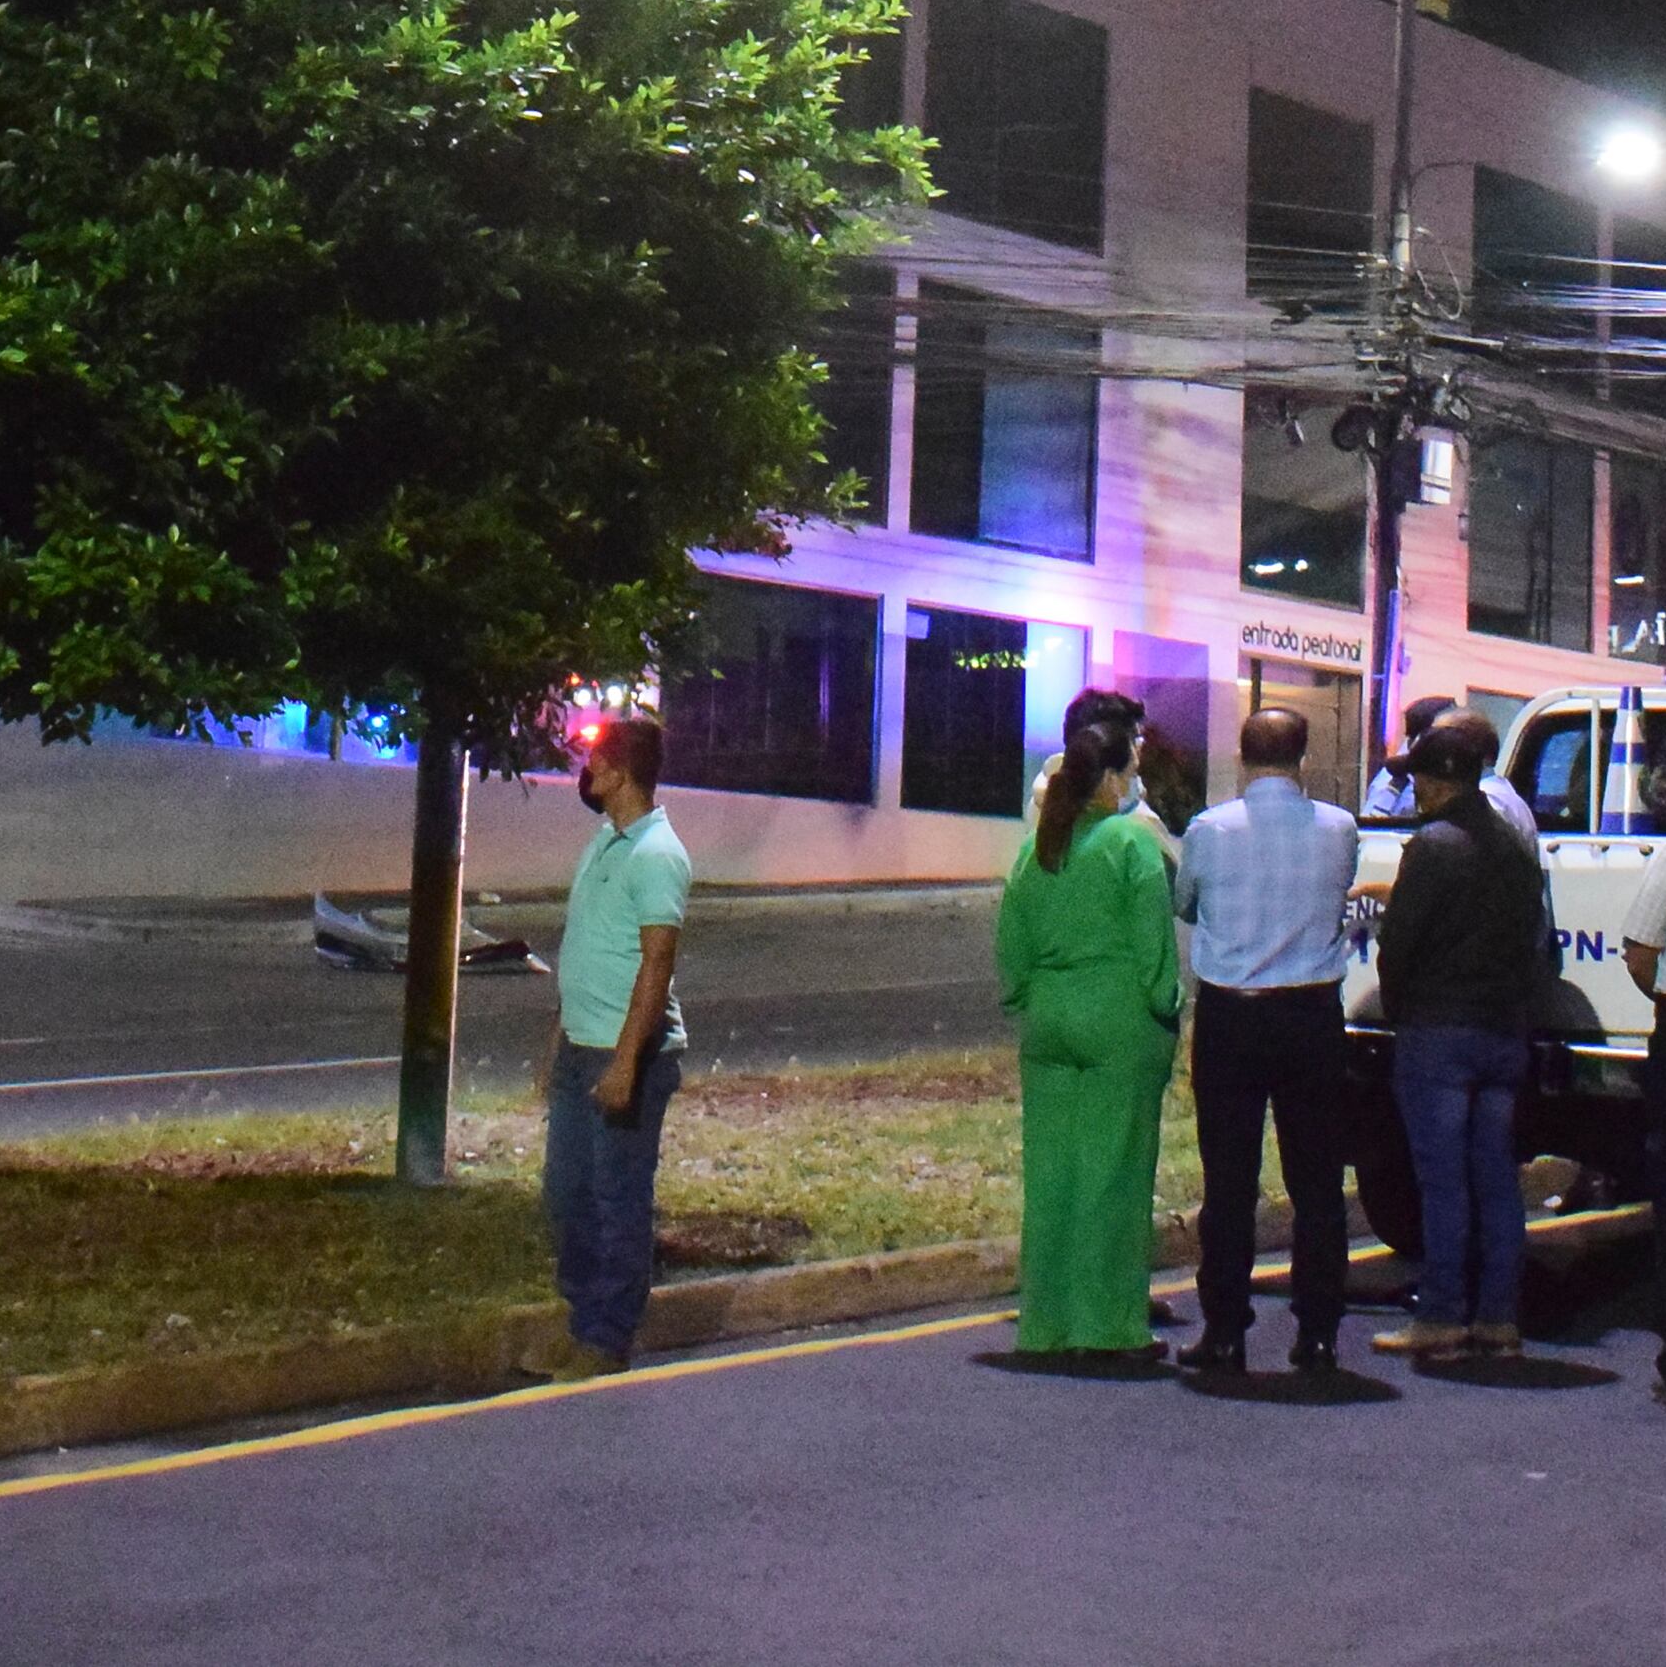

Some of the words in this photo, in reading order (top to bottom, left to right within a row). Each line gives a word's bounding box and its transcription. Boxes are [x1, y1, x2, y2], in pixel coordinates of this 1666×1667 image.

[1242, 620, 1298, 652] entrada
[1301, 634, 1362, 661] peatonal
[1552, 929, 1618, 962] PN-
